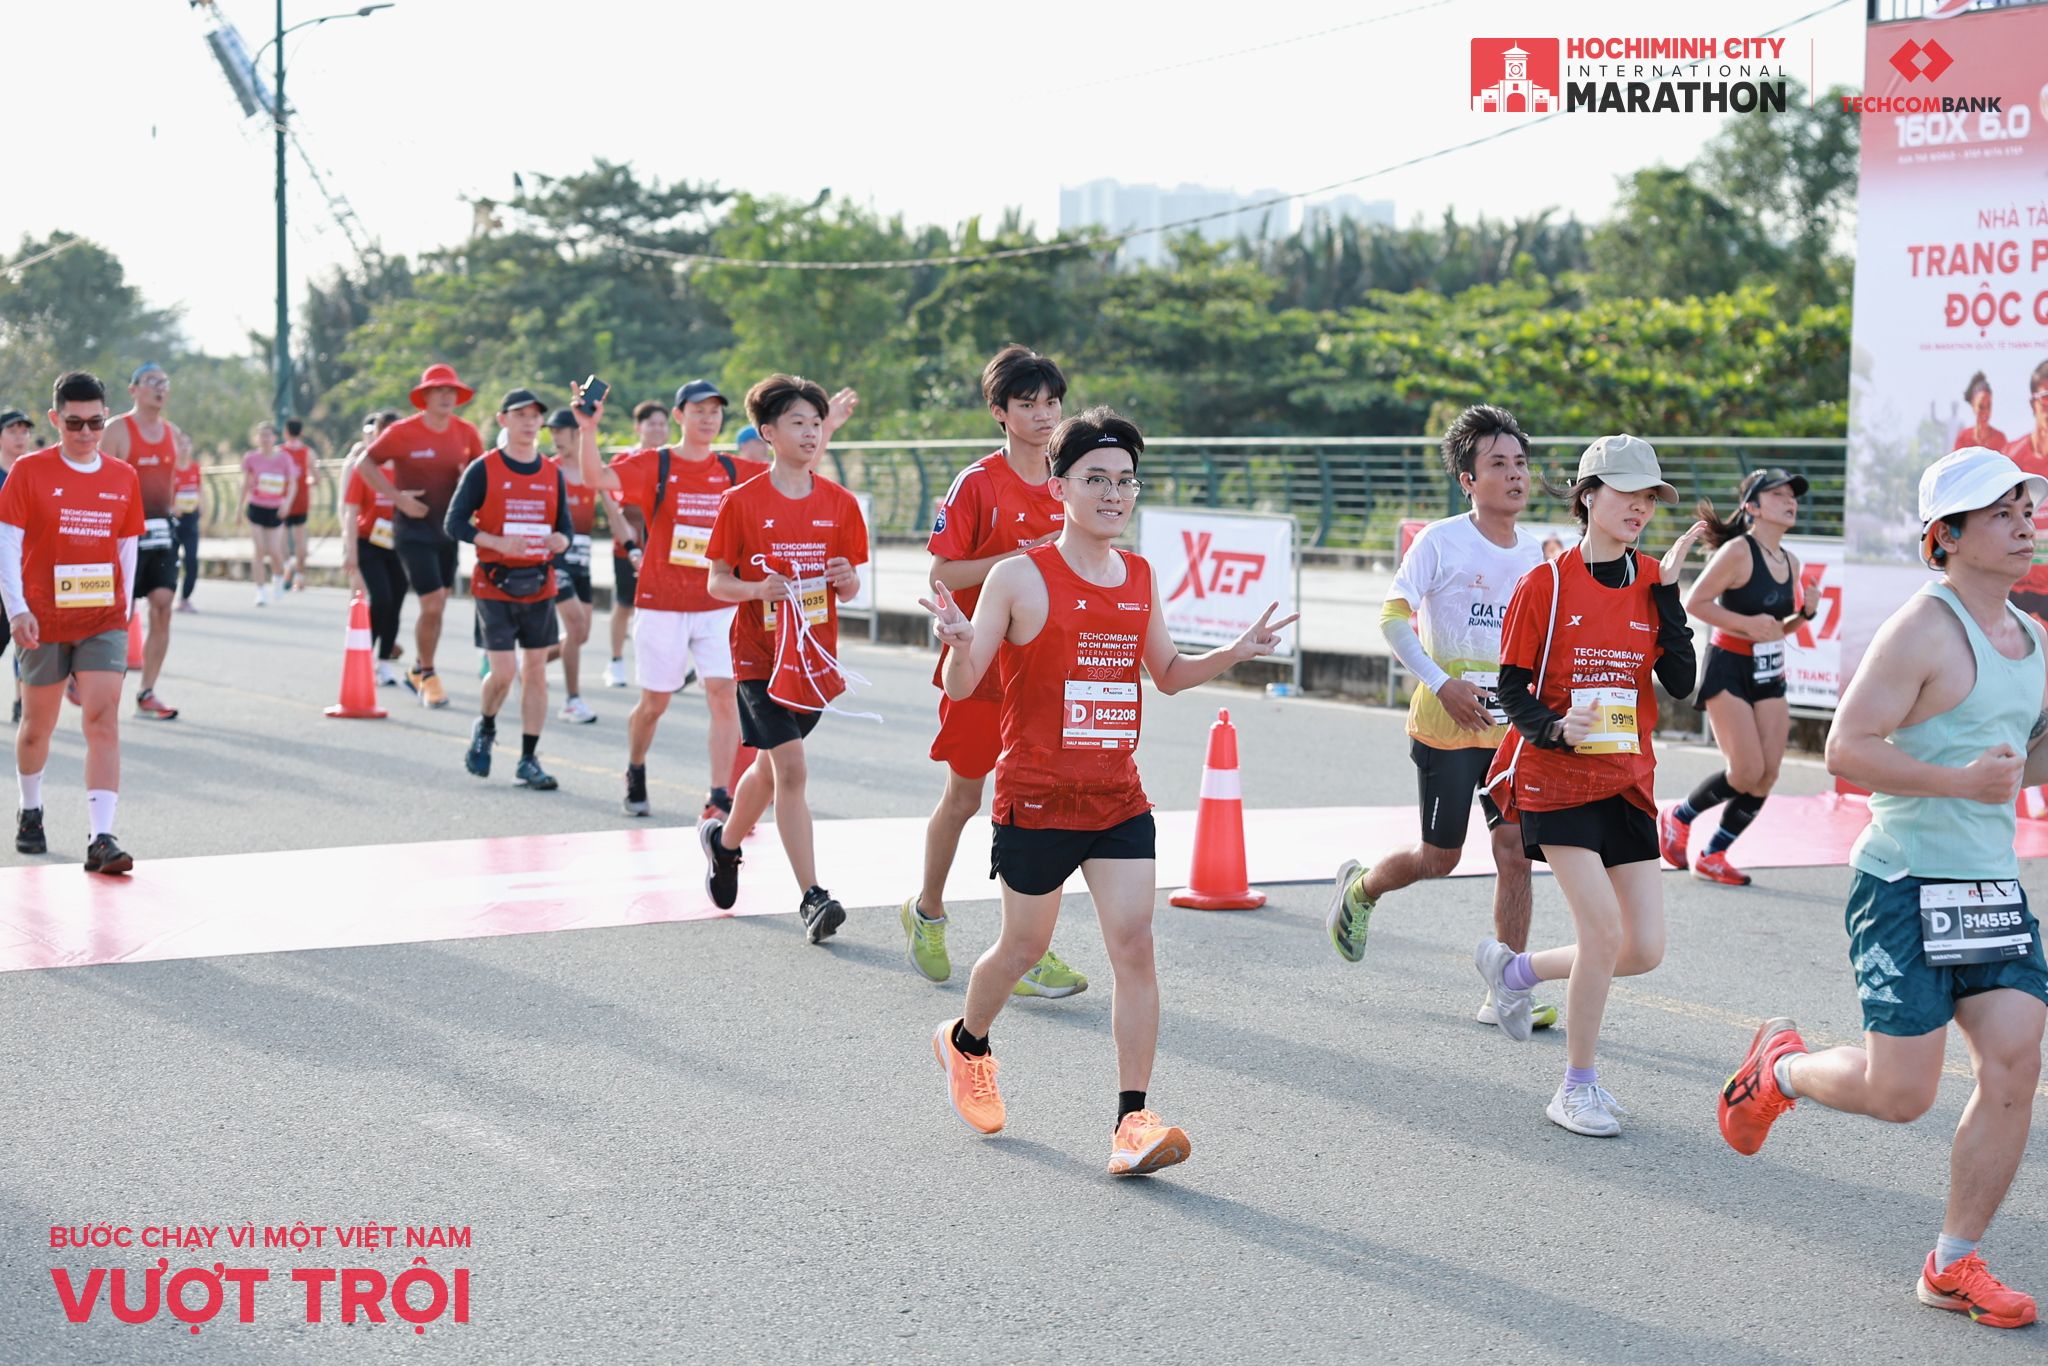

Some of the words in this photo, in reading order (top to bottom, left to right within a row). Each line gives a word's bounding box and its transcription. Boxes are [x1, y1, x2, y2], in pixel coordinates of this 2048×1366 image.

[1895, 112, 1969, 148] 160X
[1978, 104, 2031, 140] 6.0
[1978, 203, 2020, 230] NHÀ
[1907, 240, 2020, 277] TRANG
[1944, 282, 2022, 338] ĐỘC
[60, 508, 112, 518] TECHCOMBANK
[59, 526, 111, 538] MARATHON
[1166, 530, 1266, 603] XTEP
[61, 580, 72, 591] D
[1471, 602, 1494, 618] GIA
[1078, 632, 1139, 642] TECHCOMBANK
[1077, 641, 1087, 649] HO
[1088, 641, 1101, 649] CHI
[1101, 642, 1121, 650] MINH
[1077, 656, 1135, 667] MARATHON
[1573, 647, 1646, 661] TECHCOMBANK
[1087, 667, 1124, 680] 2024
[1071, 703, 1087, 723] D
[1095, 708, 1137, 721] 842208
[1930, 911, 1952, 934] D
[1963, 911, 2023, 929] 314555
